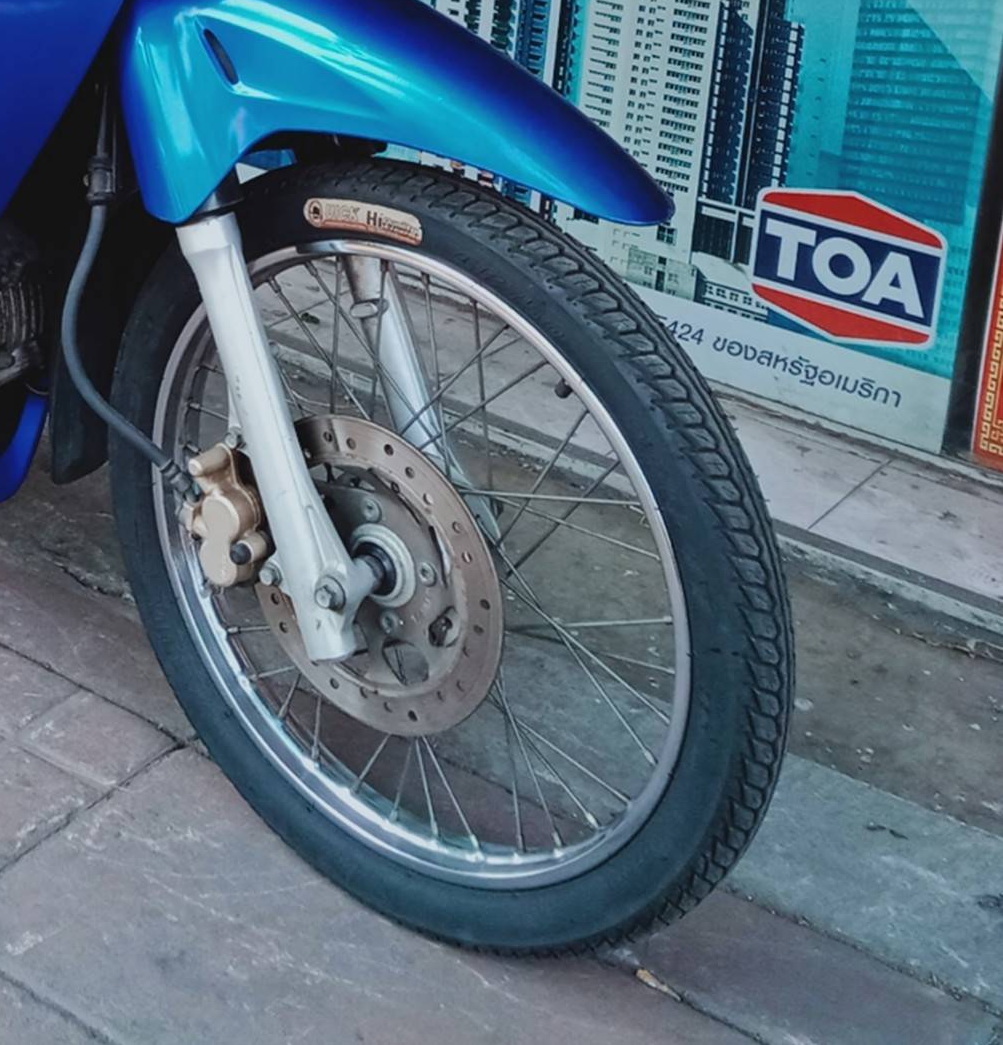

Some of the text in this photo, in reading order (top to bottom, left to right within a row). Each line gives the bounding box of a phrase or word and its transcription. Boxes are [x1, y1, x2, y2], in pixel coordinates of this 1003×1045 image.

[764, 217, 925, 319] TOA
[655, 314, 903, 409] 424 ของสหรัฐอเมริกา
